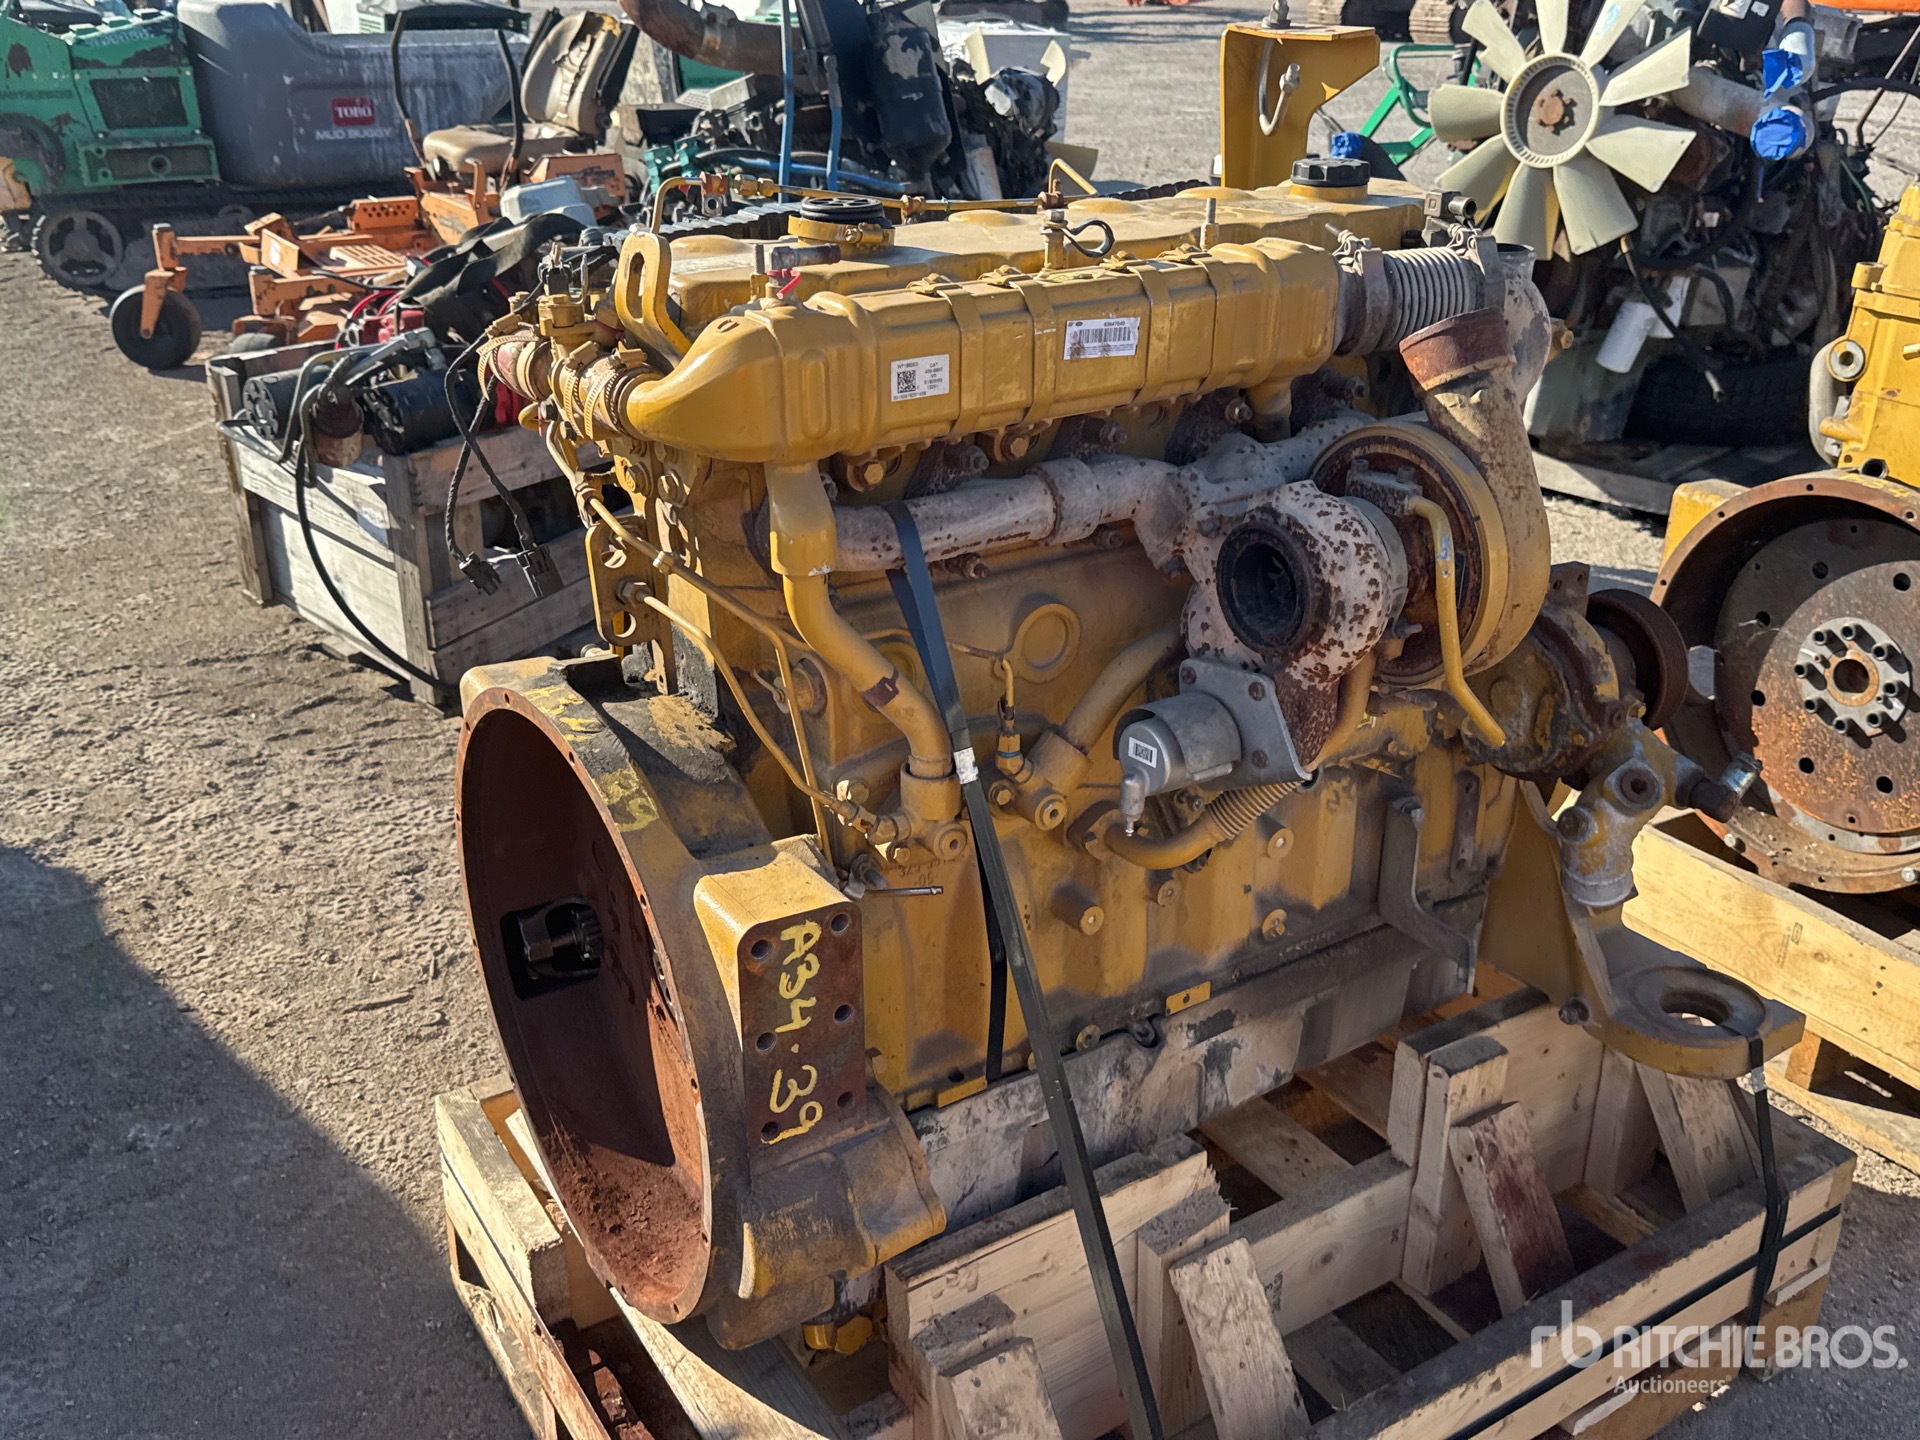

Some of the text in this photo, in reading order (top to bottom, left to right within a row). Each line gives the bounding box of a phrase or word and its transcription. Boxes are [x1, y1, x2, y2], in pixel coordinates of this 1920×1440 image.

[335, 106, 373, 119] TORO
[315, 128, 392, 140] MUD BUGGY
